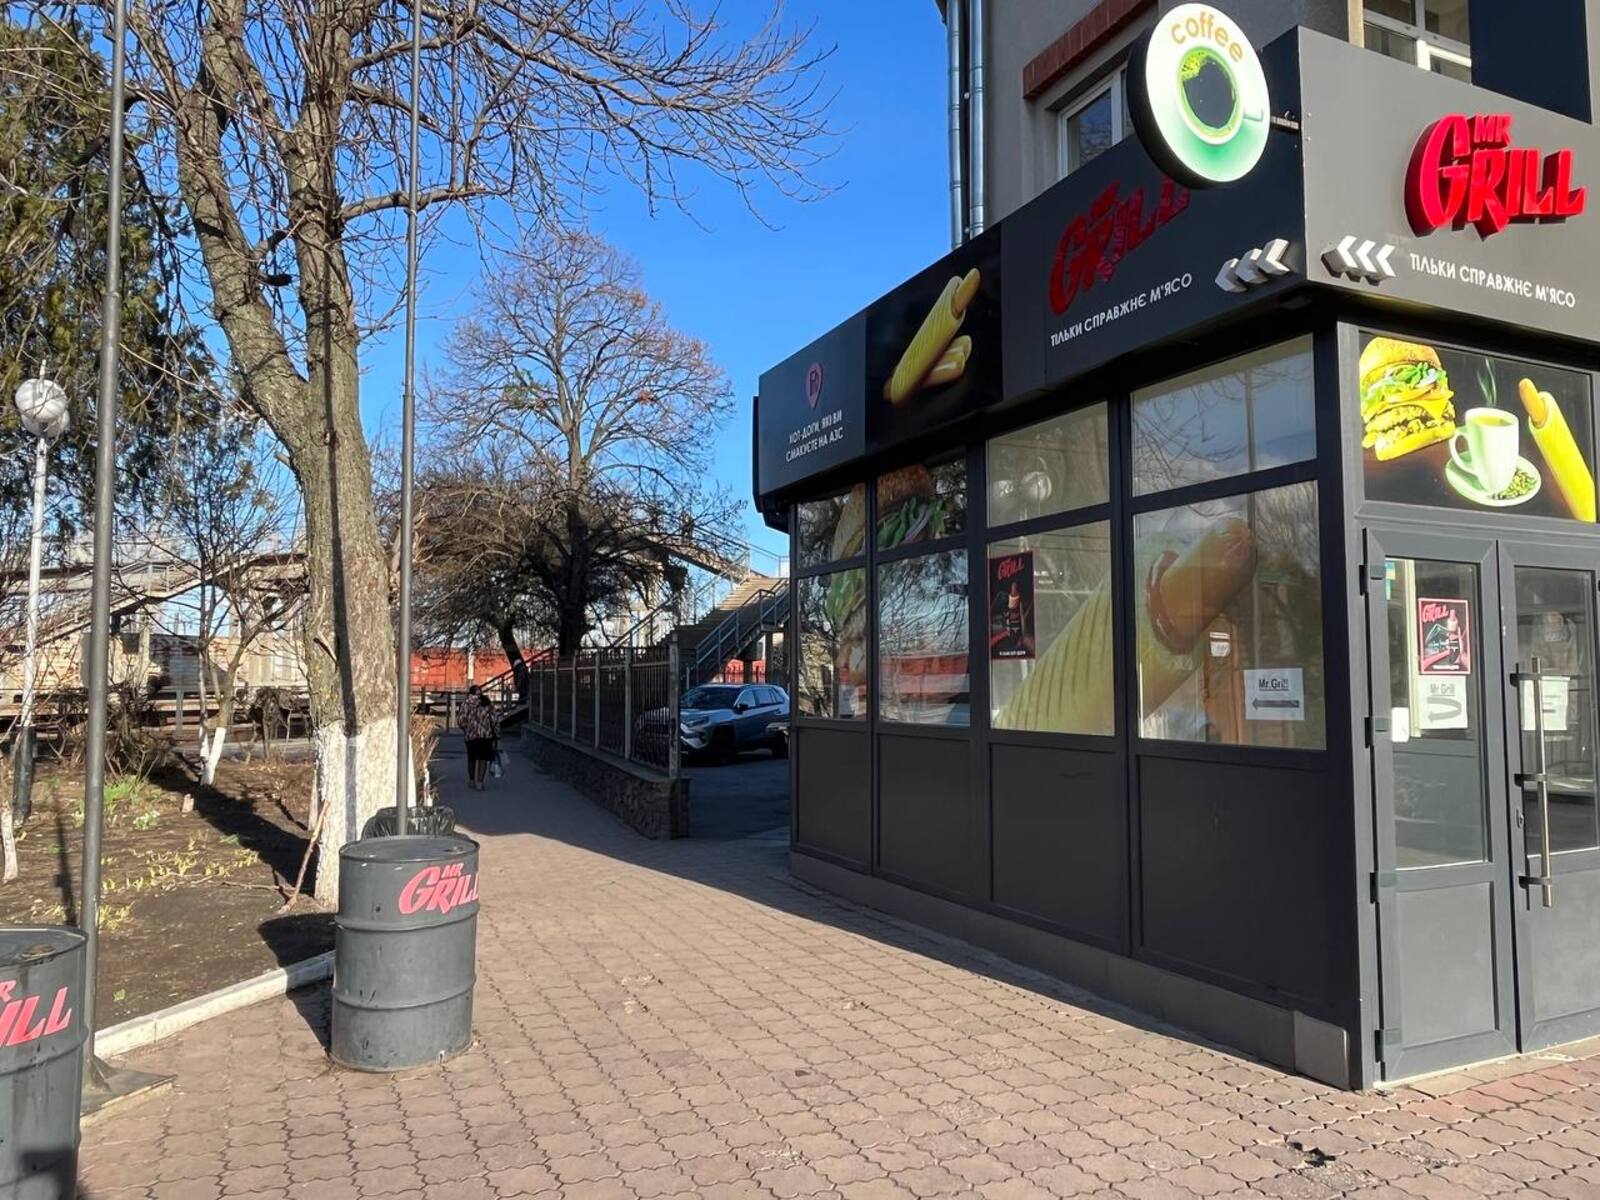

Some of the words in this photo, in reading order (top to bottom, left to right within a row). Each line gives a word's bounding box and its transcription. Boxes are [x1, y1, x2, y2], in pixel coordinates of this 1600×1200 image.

[1171, 11, 1243, 63] coffee
[1472, 113, 1512, 145] MR
[1405, 113, 1587, 240] GRILL
[1409, 253, 1457, 280] ТІЛЬКИ
[1458, 265, 1533, 298] СПРАВЖНЄ
[1535, 283, 1576, 308] М'ЯСО
[1050, 322, 1083, 347] ТІЛЬКИ
[1083, 293, 1147, 332] СПРАВЖНЄ
[1149, 272, 1193, 304] М'ЯСО
[818, 434, 828, 450] НА
[829, 426, 844, 444] АЗС
[0, 986, 73, 1048] ILL
